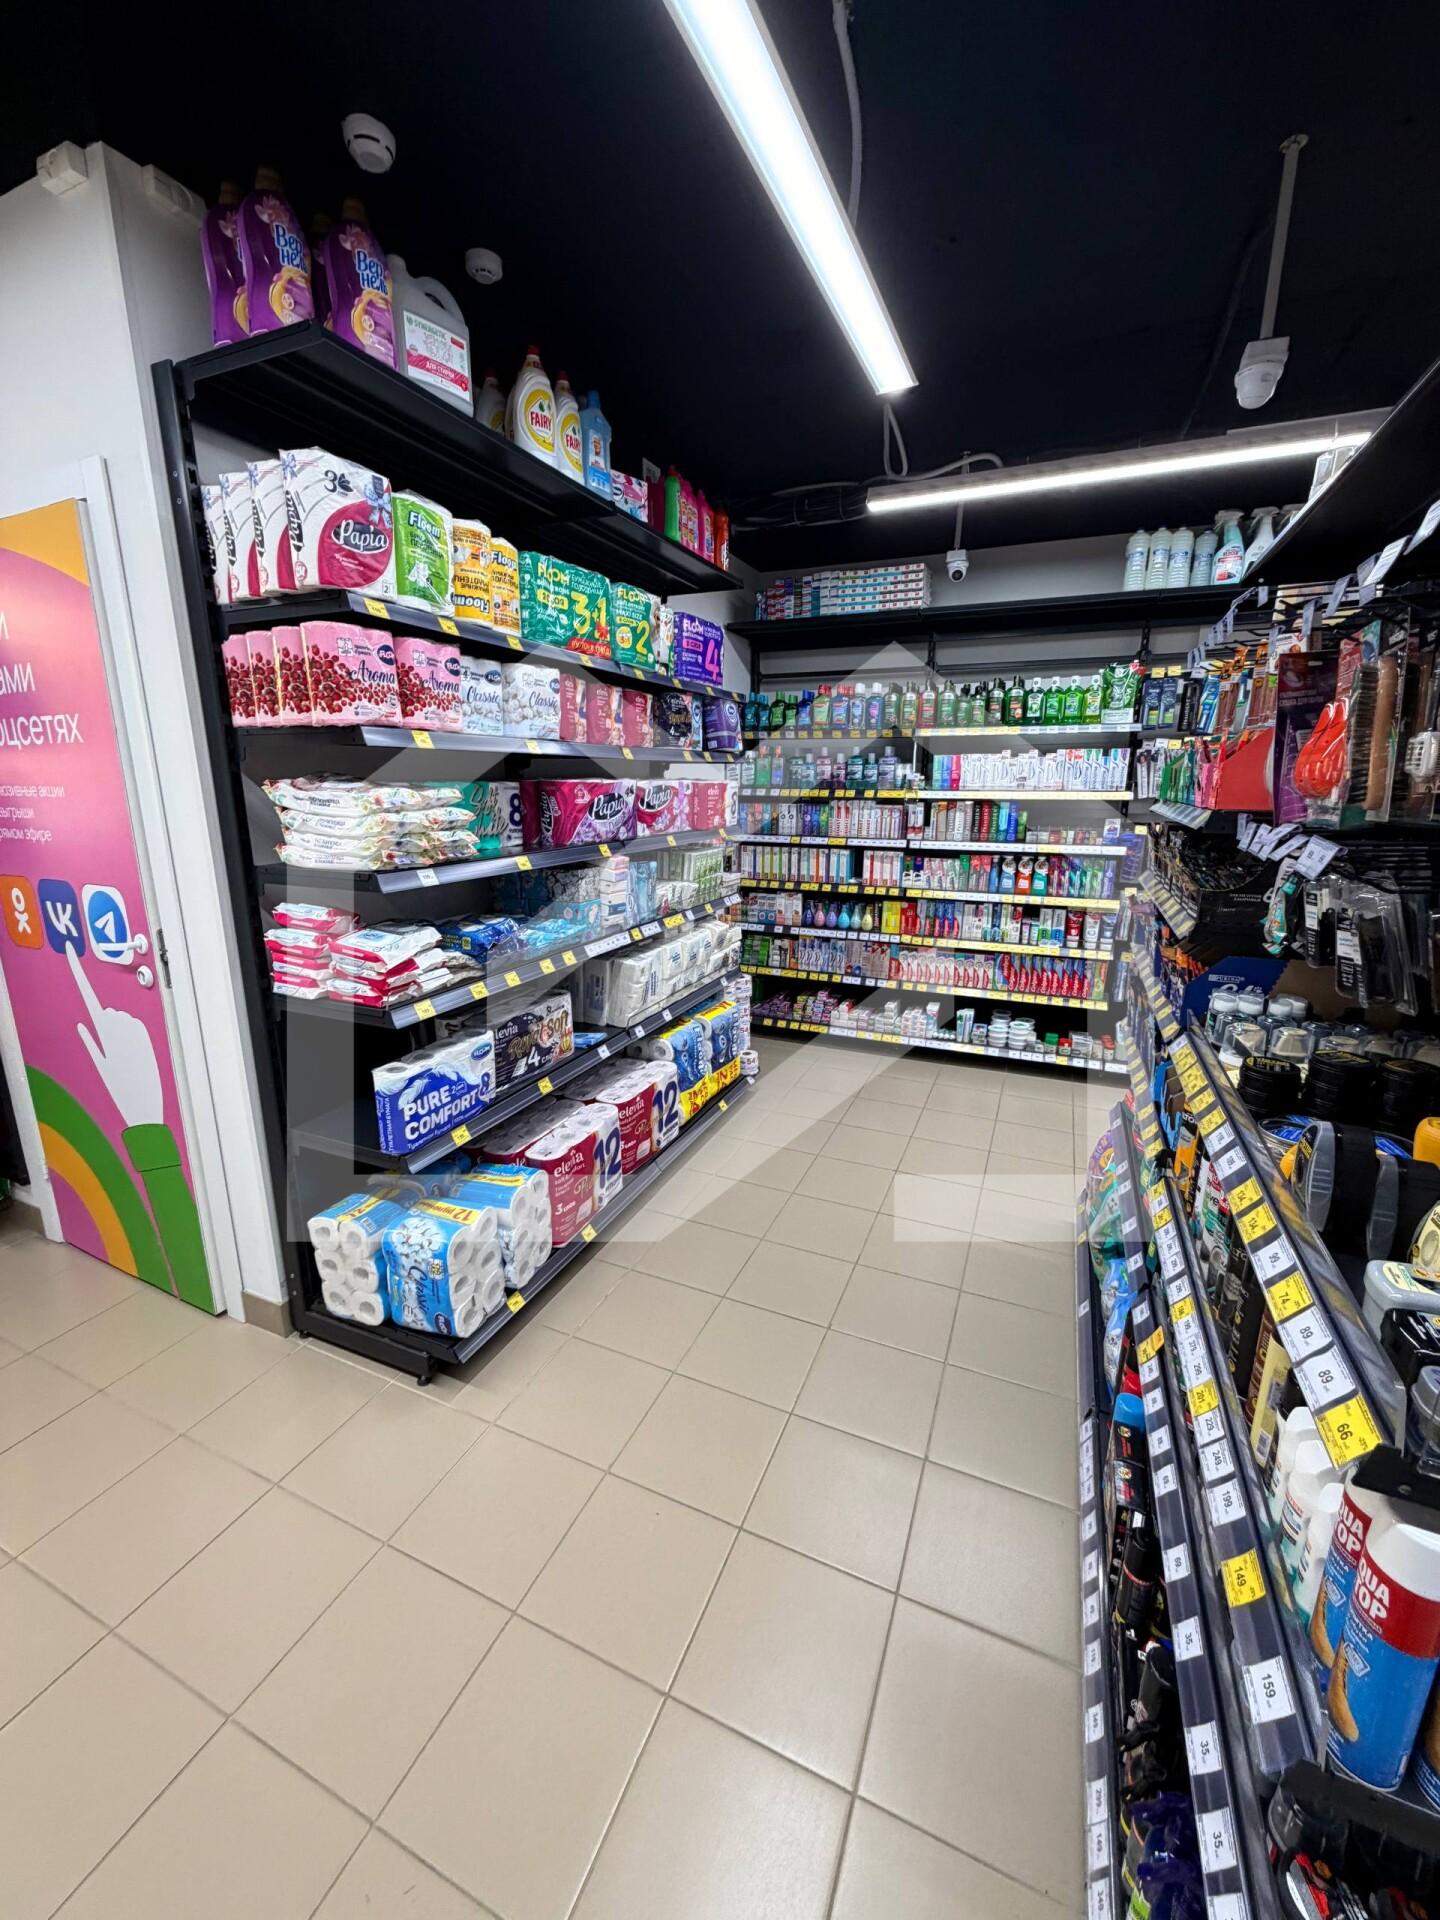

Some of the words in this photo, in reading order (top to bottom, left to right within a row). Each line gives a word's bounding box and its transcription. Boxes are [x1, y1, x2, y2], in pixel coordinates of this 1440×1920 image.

[530, 411, 552, 432] FAIRY
[565, 433, 581, 450] FAIRY
[340, 519, 386, 552] Papia
[0, 662, 36, 696] ами
[0, 713, 84, 750] цсетях
[592, 793, 625, 819] Papia
[645, 784, 673, 810] Papia
[509, 793, 521, 827] 8
[495, 1022, 519, 1040] levia
[528, 1046, 541, 1067] 4
[480, 1072, 491, 1097] 8
[403, 1085, 452, 1122] PURE
[404, 1089, 478, 1141] COMFORT
[652, 1081, 679, 1134] 12
[593, 1126, 622, 1189] 12
[1248, 1217, 1259, 1230] 134
[1267, 1252, 1279, 1265] 99
[1277, 1291, 1291, 1306] 74
[1299, 1325, 1314, 1341] 89
[1317, 1368, 1335, 1385] 89
[1336, 1422, 1354, 1442] 66
[1211, 1450, 1223, 1468] 249
[1222, 1489, 1234, 1515] 199
[1337, 1499, 1364, 1541] QUA
[1335, 1520, 1361, 1553] OP
[1232, 1566, 1248, 1588] 149
[1357, 1556, 1390, 1609] QUA
[1354, 1578, 1388, 1620] TOP
[1185, 1632, 1193, 1646] 35
[1260, 1672, 1277, 1700] 159
[1200, 1740, 1210, 1756] 35
[1213, 1830, 1222, 1849] 35
